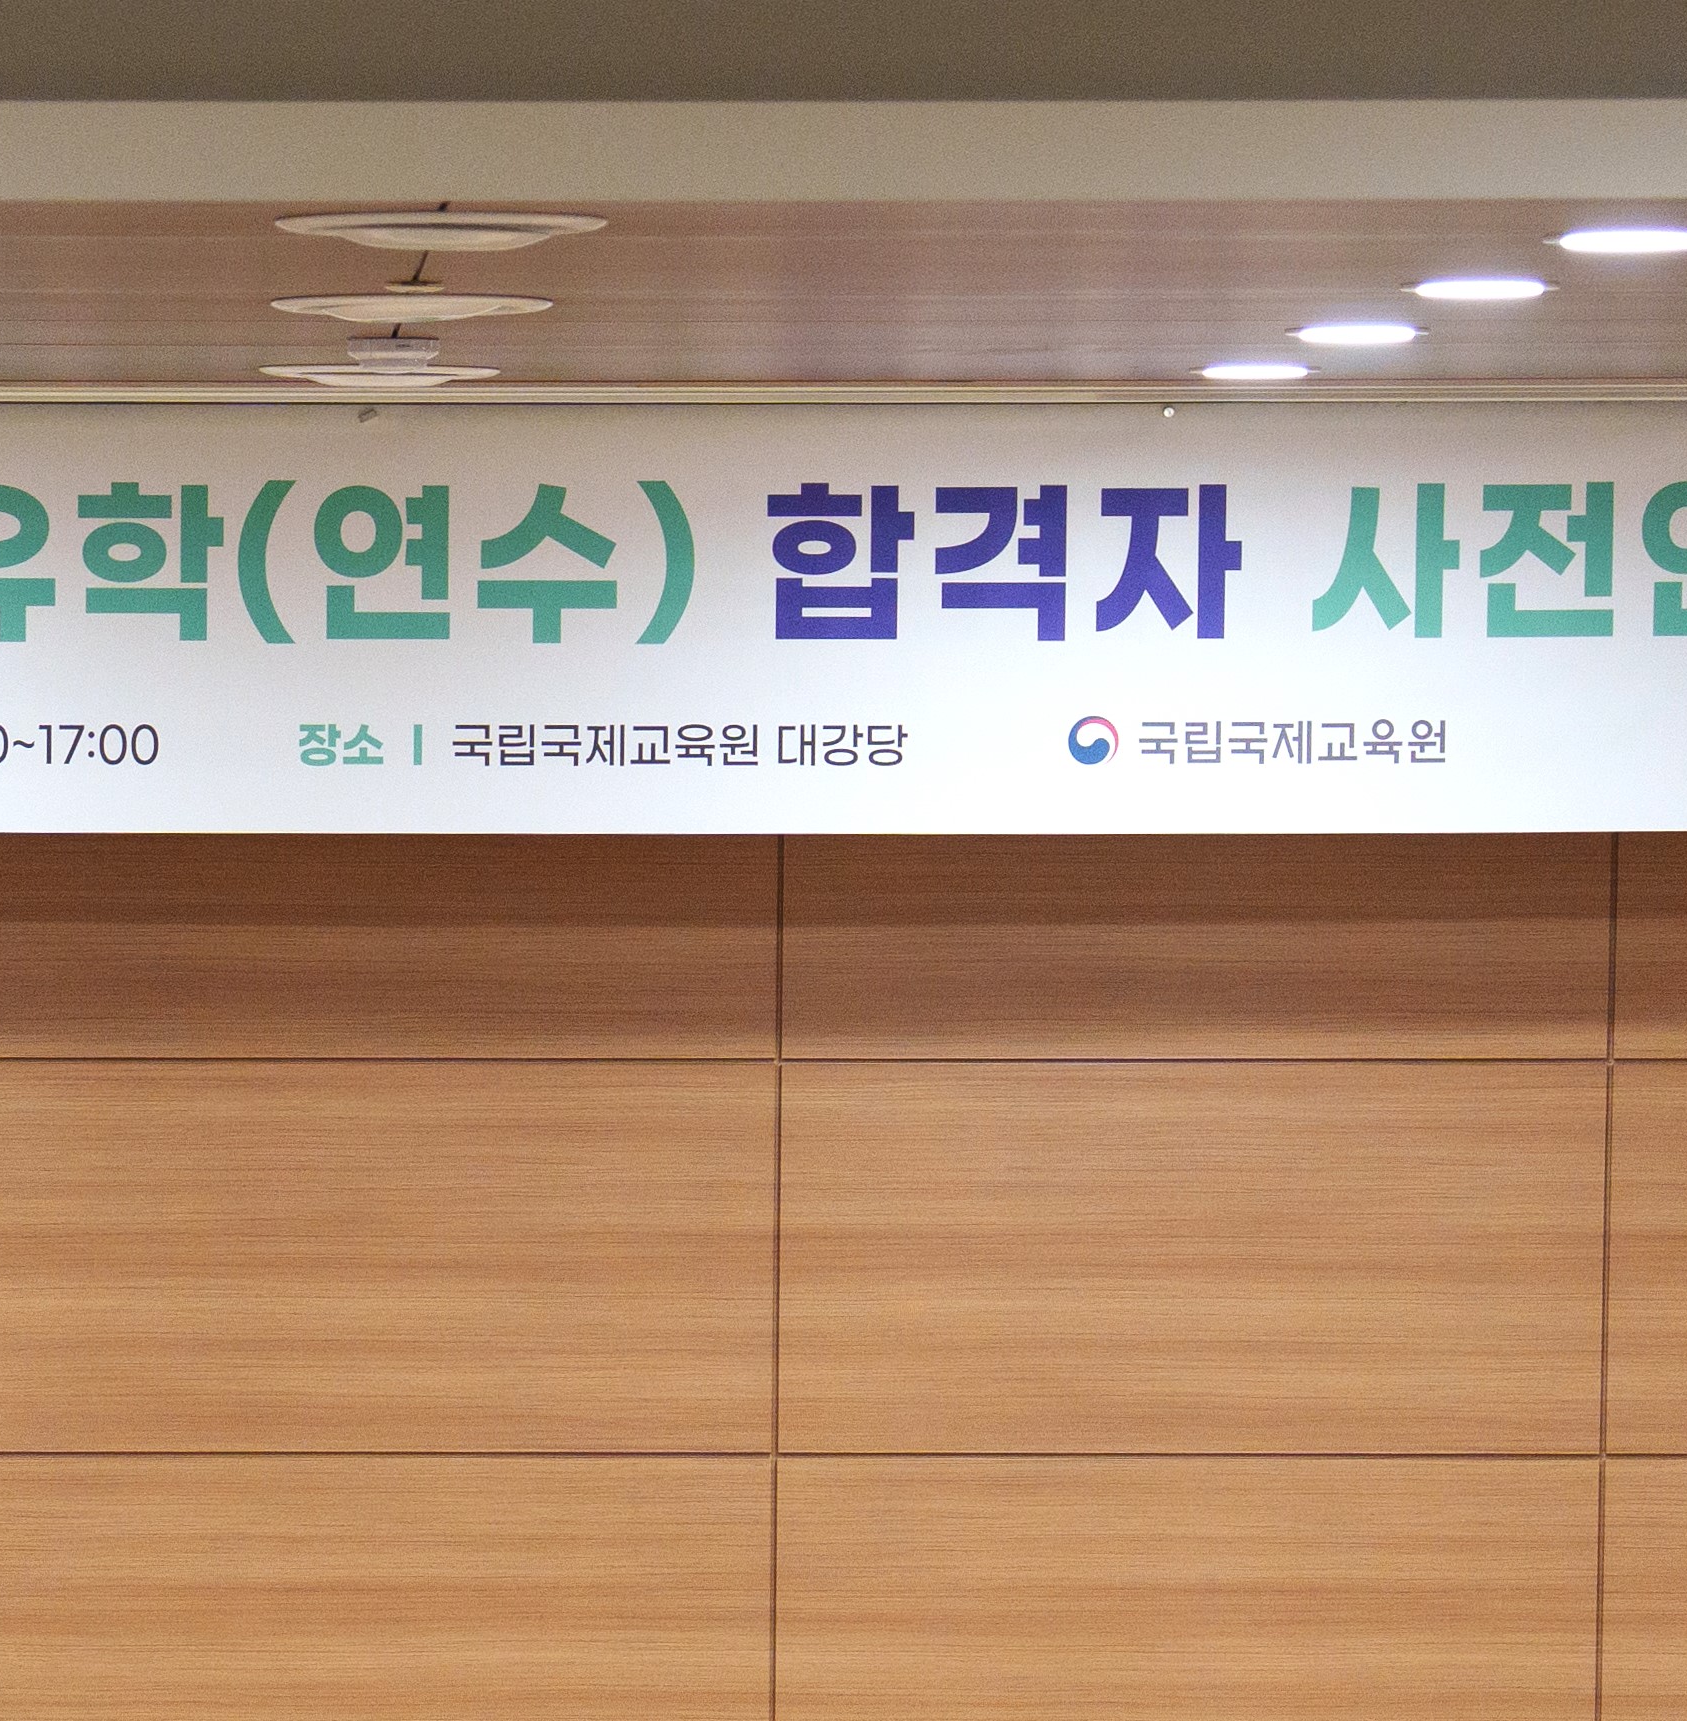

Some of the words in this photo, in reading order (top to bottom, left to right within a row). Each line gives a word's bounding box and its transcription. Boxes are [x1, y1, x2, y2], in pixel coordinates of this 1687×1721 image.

[766, 481, 1243, 641] 합격자
[298, 723, 385, 767] 장소
[451, 723, 760, 767] 국립국제교육원
[776, 723, 910, 767] 대강당
[1138, 717, 1448, 765] 국립국제교육원
